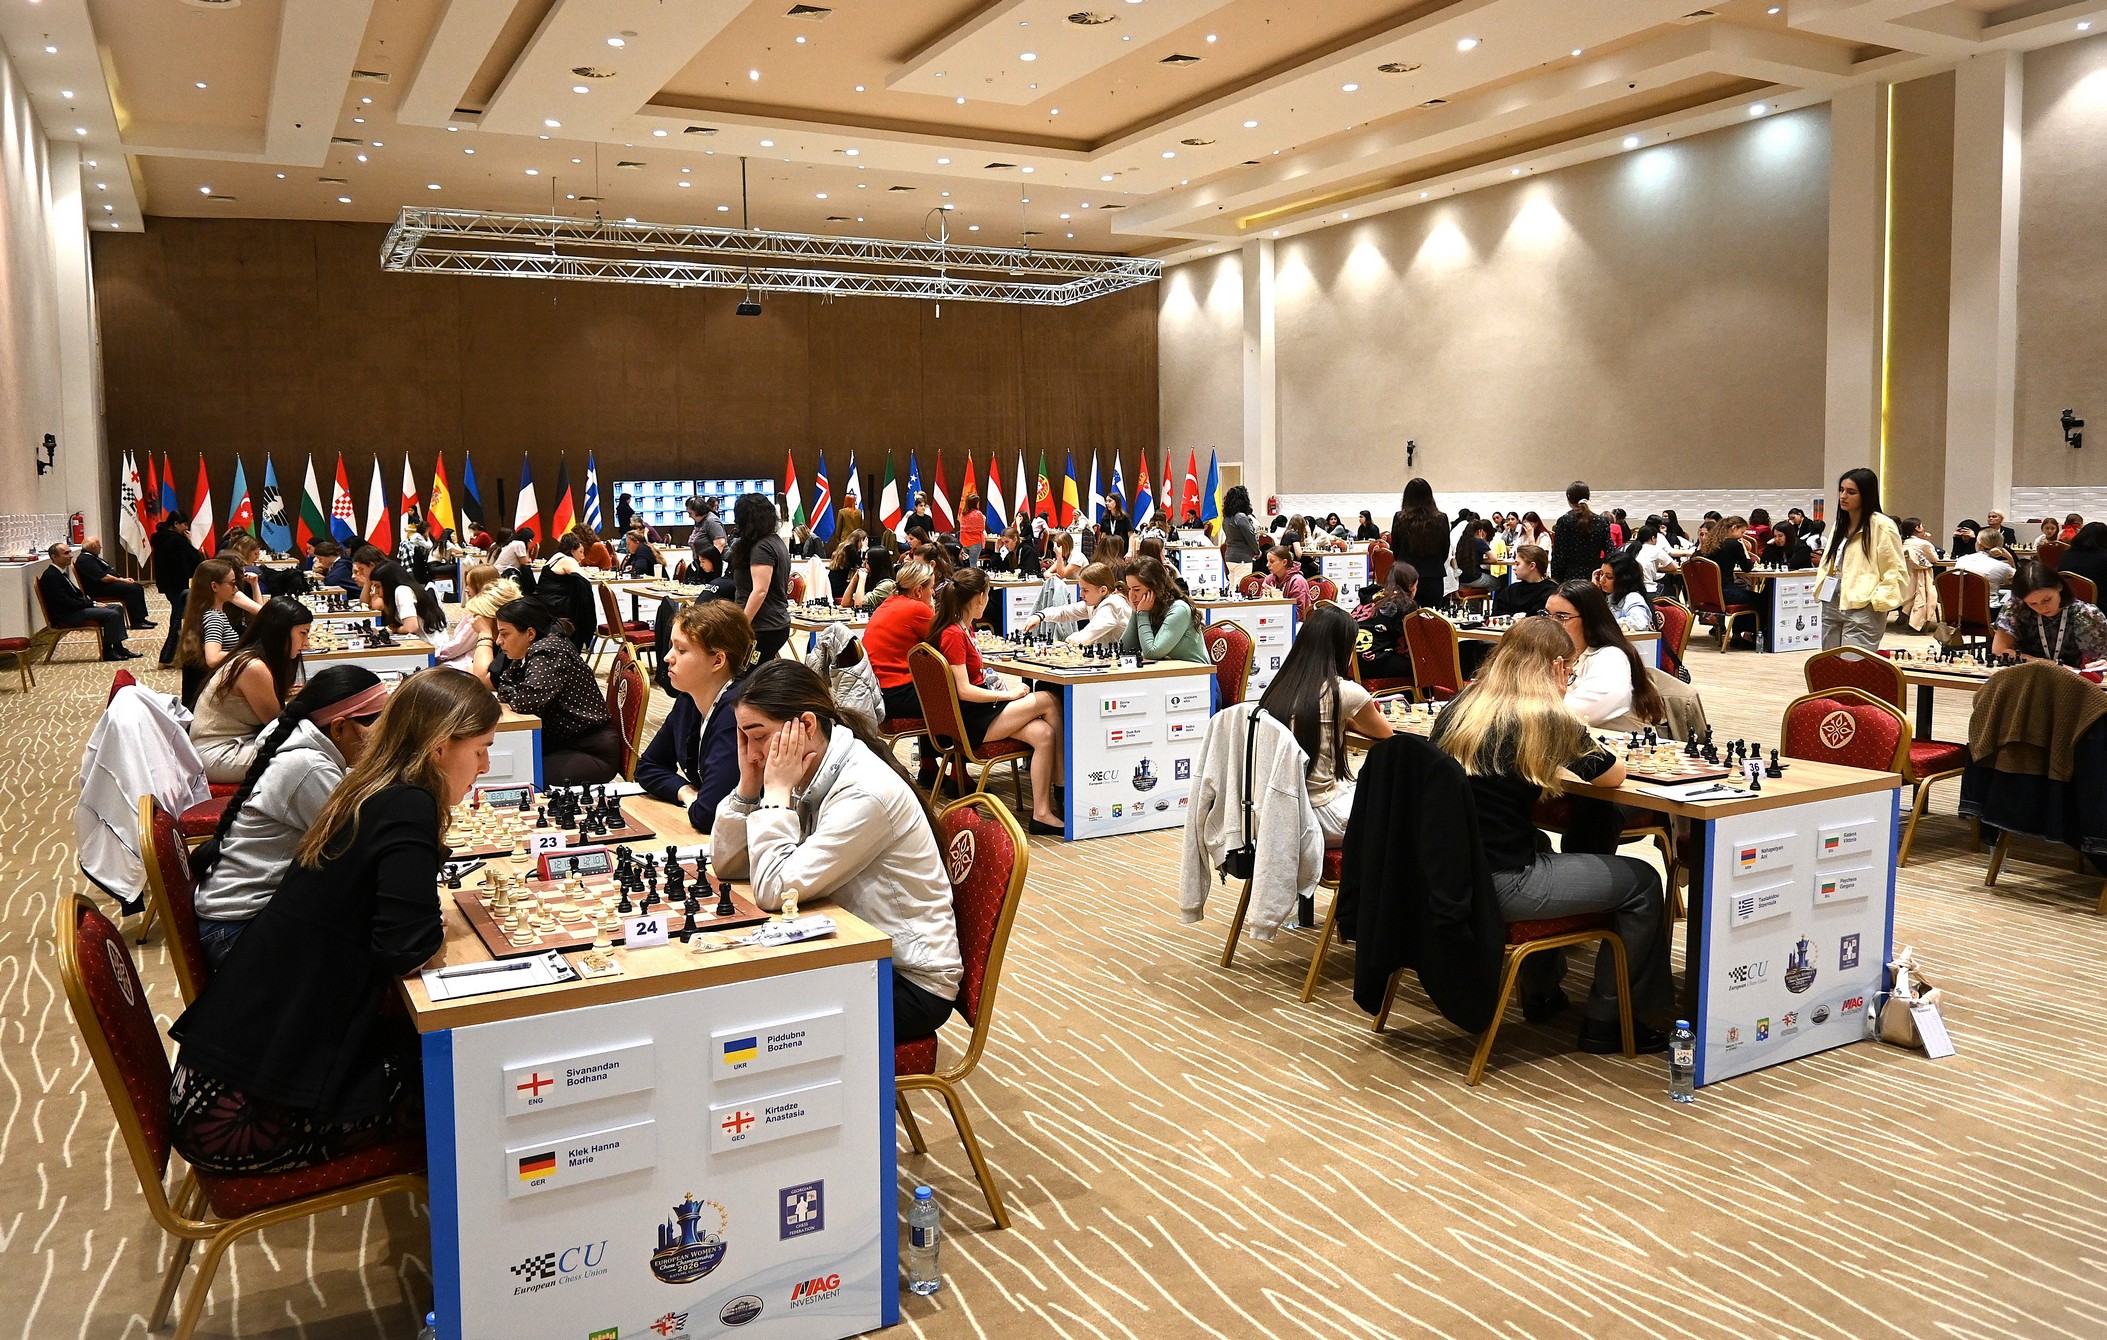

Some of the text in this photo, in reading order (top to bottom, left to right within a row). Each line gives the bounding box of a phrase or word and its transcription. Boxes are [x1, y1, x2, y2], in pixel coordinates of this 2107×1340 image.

[1749, 762, 1760, 772] 36
[539, 836, 557, 848] 23
[636, 920, 658, 936] 24
[1841, 996, 1864, 1012] MAG
[767, 1030, 806, 1044] Piddubna
[767, 1040, 803, 1052] Bozhena
[566, 1061, 620, 1077] Sivanandan
[733, 1062, 748, 1070] UKR
[566, 1072, 608, 1086] Bodhana
[528, 1097, 544, 1105] ENG
[765, 1102, 799, 1115] Kirtadze
[765, 1109, 805, 1124] Anastasia
[731, 1134, 746, 1142] GEO
[568, 1141, 620, 1158] Klek Hanna
[568, 1156, 594, 1167] Marie
[530, 1178, 546, 1187] GER
[789, 1226, 815, 1236] FEDERATION
[538, 1239, 608, 1280] ECU
[654, 1253, 690, 1267] EUROPEAN
[677, 1261, 699, 1273] 2026
[513, 1267, 608, 1296] European Chess Union
[790, 1273, 841, 1301] MAG
[790, 1288, 841, 1310] INVESTMENT
